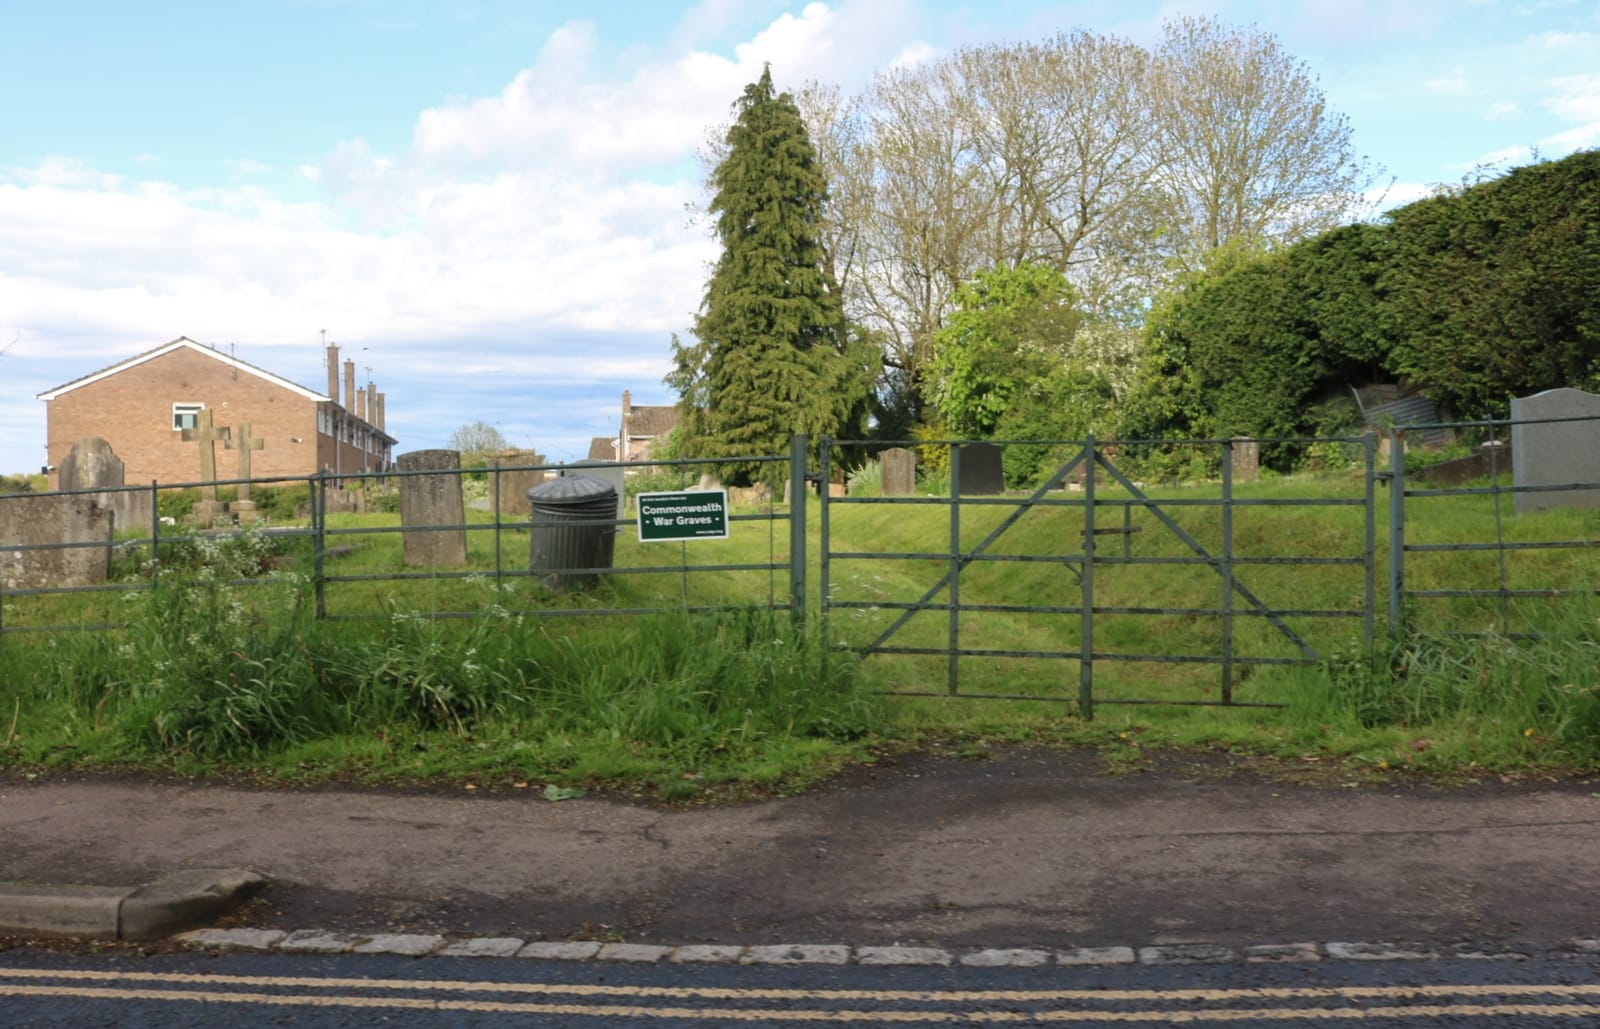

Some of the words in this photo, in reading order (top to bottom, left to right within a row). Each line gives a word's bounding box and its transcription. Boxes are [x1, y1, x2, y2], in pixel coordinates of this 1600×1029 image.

[642, 503, 722, 515] Commonwealth
[653, 516, 674, 526] War
[676, 516, 712, 525] Graves
